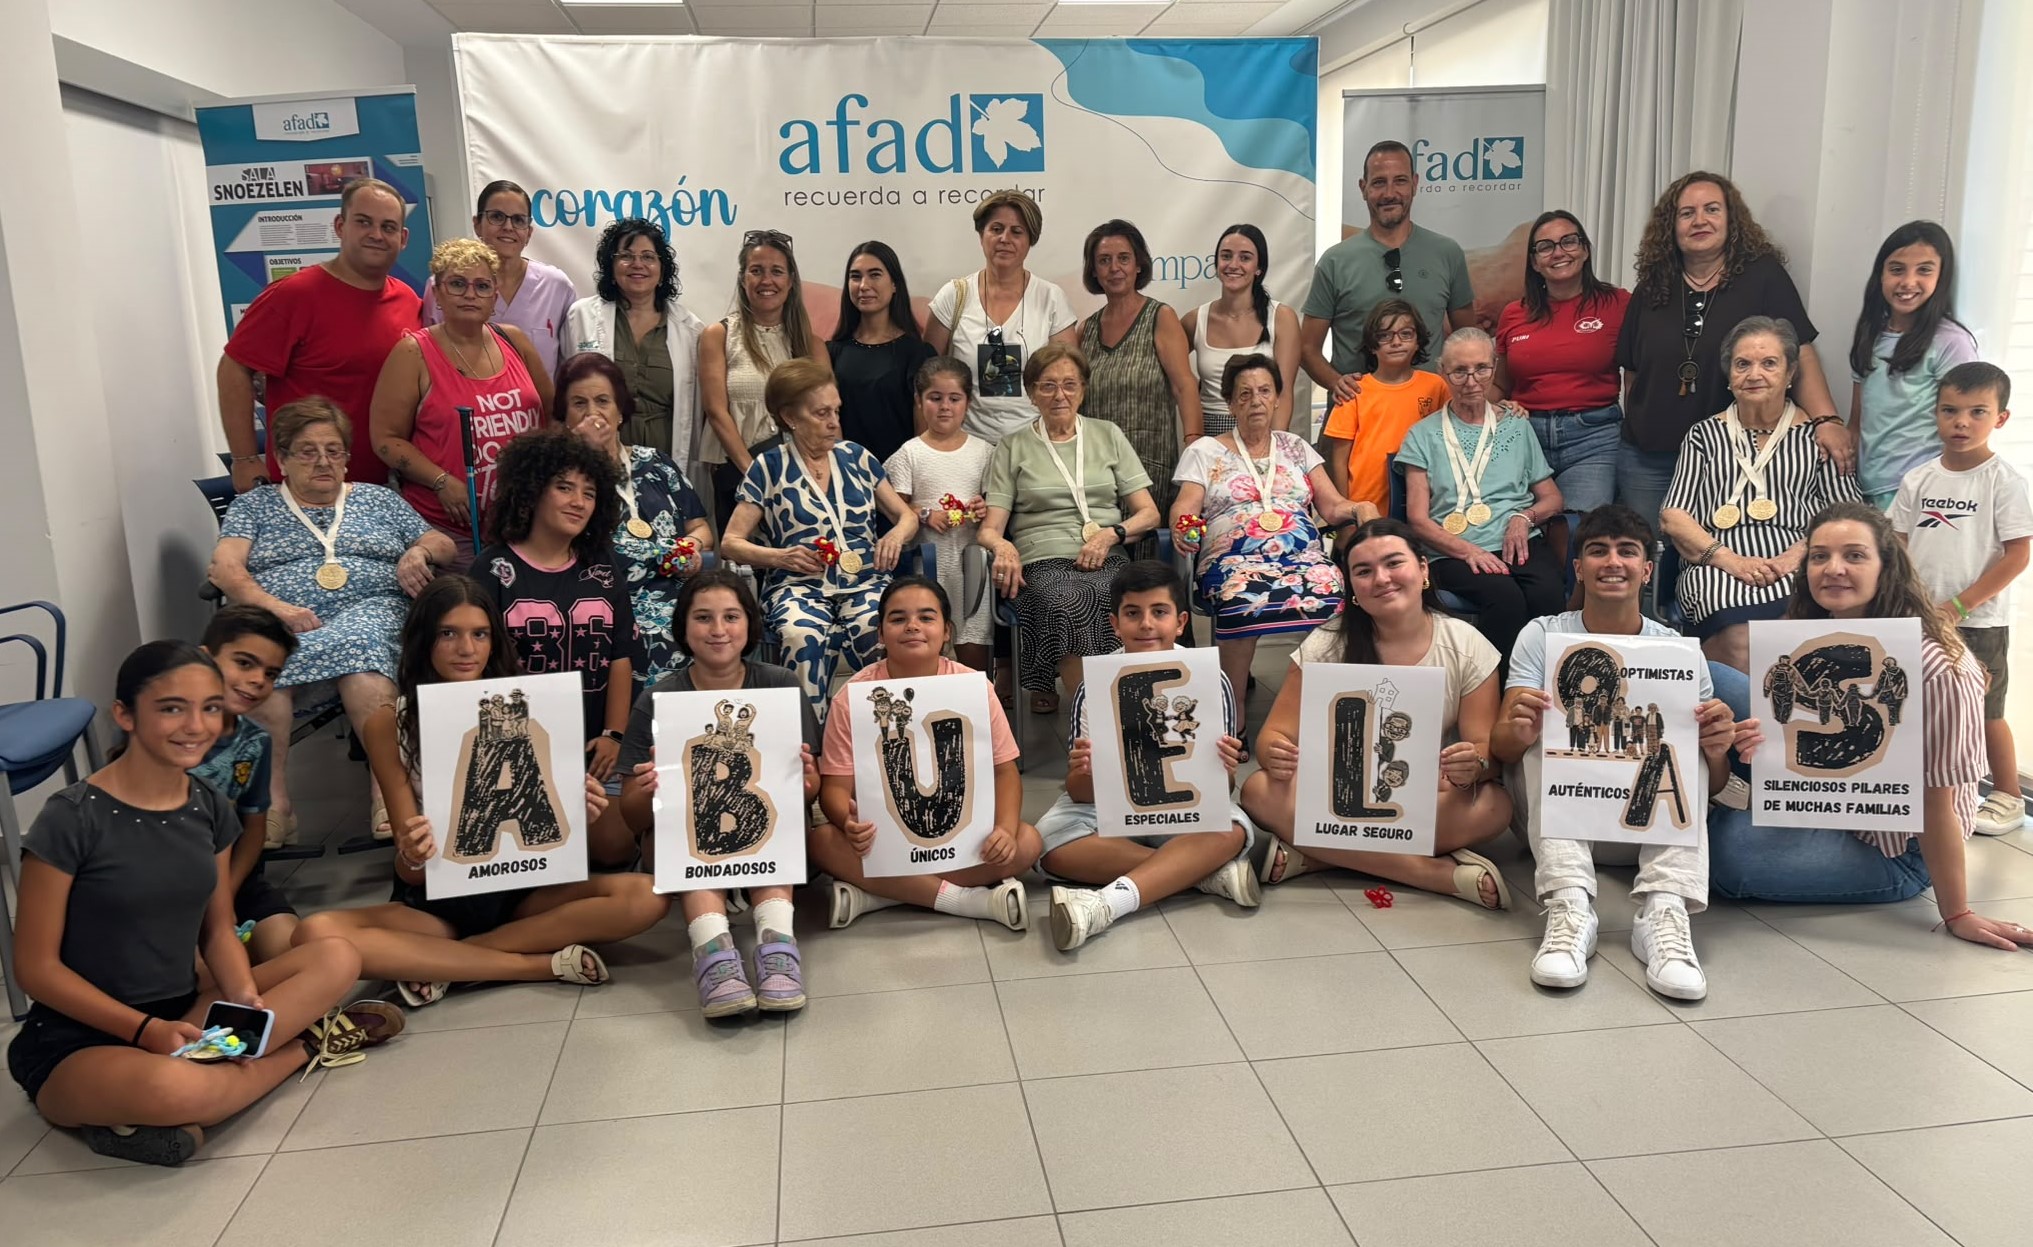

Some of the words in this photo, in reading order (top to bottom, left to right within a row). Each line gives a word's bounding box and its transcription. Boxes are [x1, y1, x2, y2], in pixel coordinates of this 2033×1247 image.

[283, 113, 316, 131] afad
[778, 93, 963, 175] afad
[1412, 138, 1479, 181] fad
[241, 167, 276, 181] SALA
[214, 180, 304, 200] SNOEZELEN
[785, 186, 900, 206] recuerda
[913, 189, 928, 205] a
[939, 184, 1045, 205] recoar
[1462, 183, 1522, 192] recordar
[258, 214, 303, 222] INTRODUCCIÓN
[531, 175, 737, 244] corazón
[475, 388, 521, 413] NOT
[470, 408, 541, 439] RIENDLY
[1921, 497, 1978, 512] reebok
[1620, 667, 1694, 681] OPTIMISTAS
[1118, 668, 1195, 807] E
[1332, 697, 1398, 818] L
[881, 717, 966, 839] U
[1763, 779, 1847, 794] SILENCIOSOS
[1851, 782, 1910, 795] PILARES
[453, 738, 563, 858] A
[690, 743, 769, 857] B
[1548, 781, 1630, 800] AUTÉNTICOS
[1763, 799, 1781, 811] DE
[1785, 801, 1842, 814] MUCHAS
[1846, 803, 1911, 816] FAMILIAS
[1124, 812, 1201, 826] ESPECIALES
[1315, 822, 1358, 837] LUGAR
[1362, 826, 1413, 841] SEGURO
[910, 847, 956, 863] ÚNICOS
[468, 857, 547, 879] AMOROSOS
[684, 861, 776, 879] BONDADOSOS
